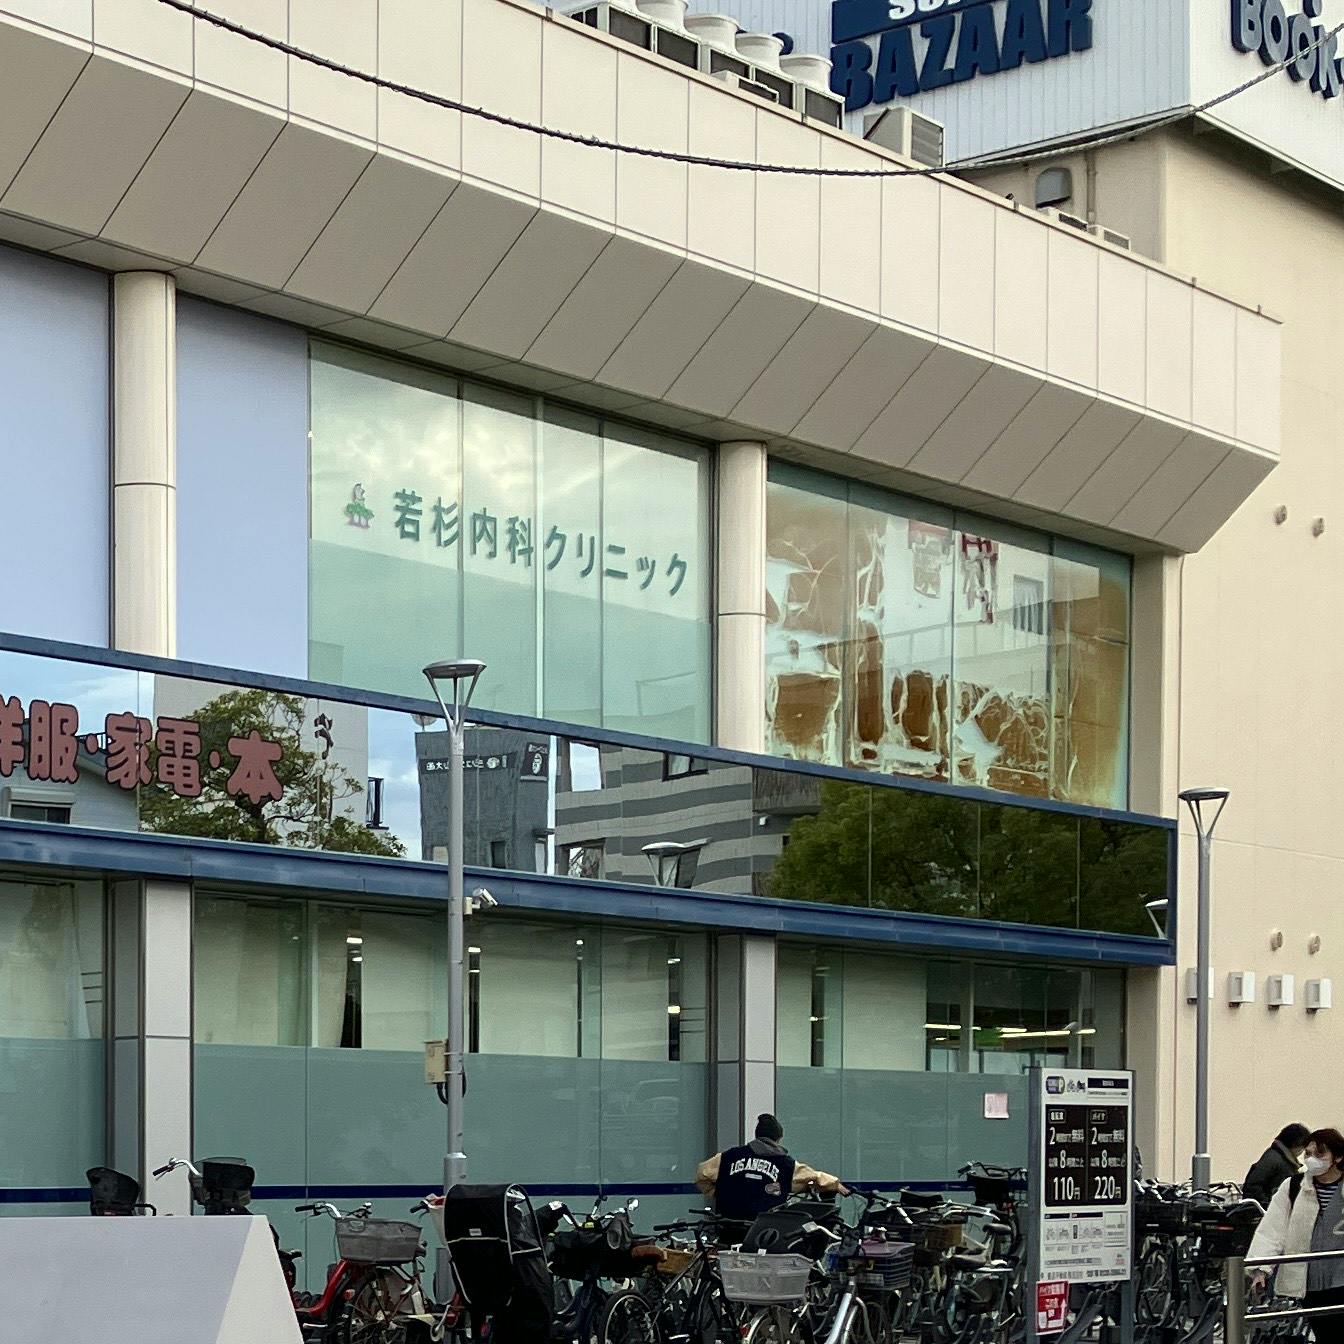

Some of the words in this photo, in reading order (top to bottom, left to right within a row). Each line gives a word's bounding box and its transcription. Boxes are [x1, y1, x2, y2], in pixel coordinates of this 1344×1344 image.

[830, 0, 1093, 113] BAZAAR
[393, 488, 688, 597] 若杉内科クリニック
